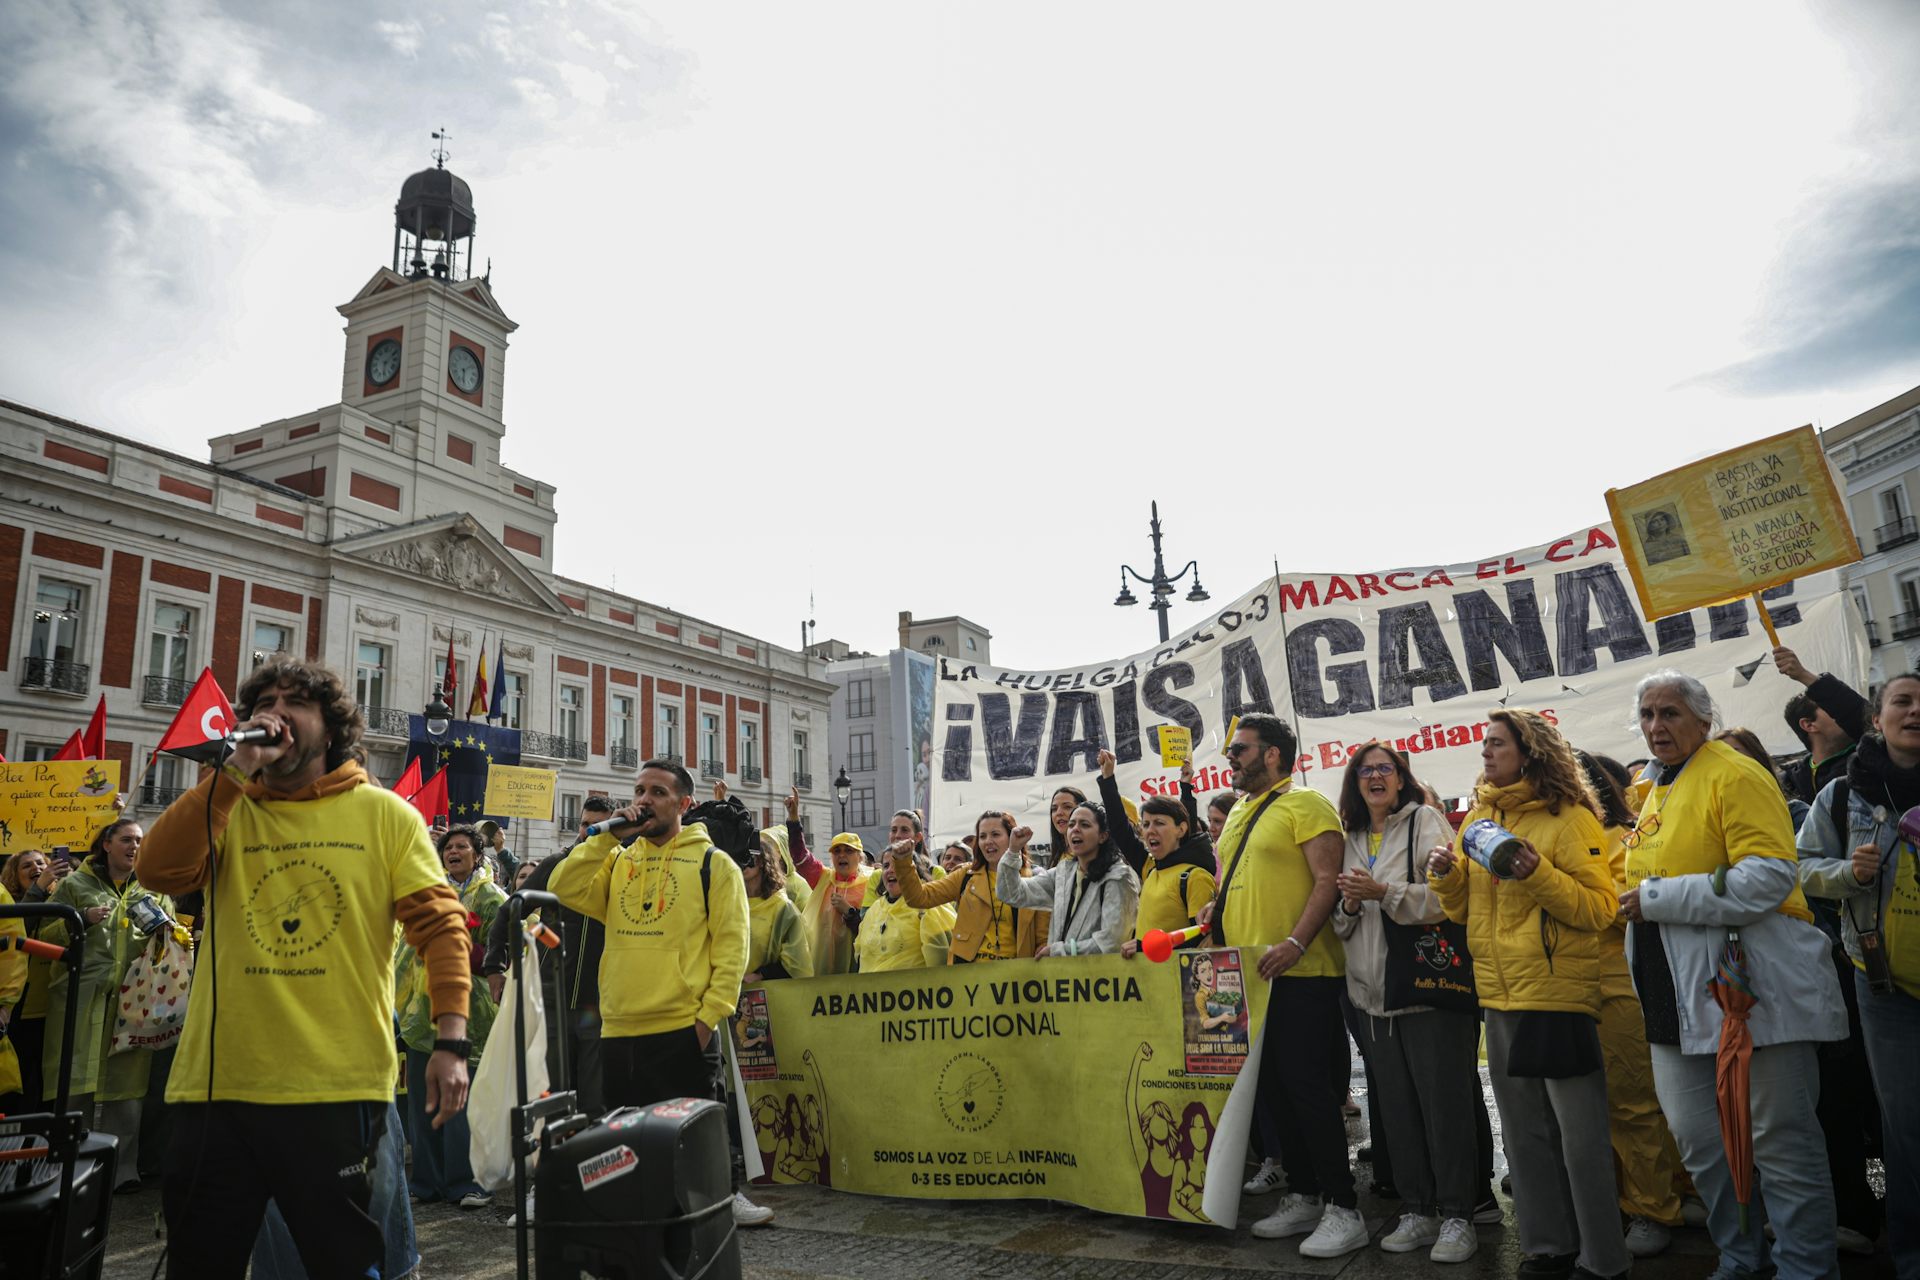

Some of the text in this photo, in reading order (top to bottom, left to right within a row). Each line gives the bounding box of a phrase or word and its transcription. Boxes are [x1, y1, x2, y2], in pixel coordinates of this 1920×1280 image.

[1715, 454, 1784, 488] BASTA YA
[1726, 472, 1781, 501] DE ABUSO
[1718, 483, 1809, 521] INSTITUCIONAL
[1731, 511, 1804, 543] LA INFANCIA
[1733, 521, 1820, 557] NO SE RECORTA
[1741, 537, 1816, 566] SE DEFIENDE
[1748, 549, 1816, 577] Y SE CUIDA
[995, 661, 1138, 692] HUELGA
[1280, 568, 1453, 613] MARCA
[1475, 557, 1526, 580] EL
[1221, 636, 1276, 738] A
[32, 763, 57, 782] Pan
[507, 780, 546, 791] EDUCACIÓN
[11, 789, 45, 806] quiere
[31, 807, 39, 818] y
[25, 819, 66, 840] llegamos
[70, 824, 78, 832] a
[282, 842, 298, 851] VOZ
[300, 841, 312, 849] DE
[326, 841, 365, 851] INFANCIA
[312, 861, 343, 905] LABORAL
[246, 911, 280, 957] ESCUELAS
[258, 966, 270, 975] ES
[272, 966, 327, 977] EDUCACIÓN
[811, 977, 1142, 1016] ABANDONO Y VIOLENCIA
[128, 1024, 183, 1046] ZEEMAN
[881, 1012, 1061, 1042] INSTITUCIONAL
[976, 1055, 1003, 1089] LABORAL
[1141, 1079, 1234, 1091] CONDICIONES LABORA
[581, 1151, 623, 1174] IZQUIERDA
[874, 1150, 1078, 1168] SOMOS LA VOZ DE LA INFANCIA
[912, 1168, 1046, 1186] 0-3 ES EDUCACIÓN
